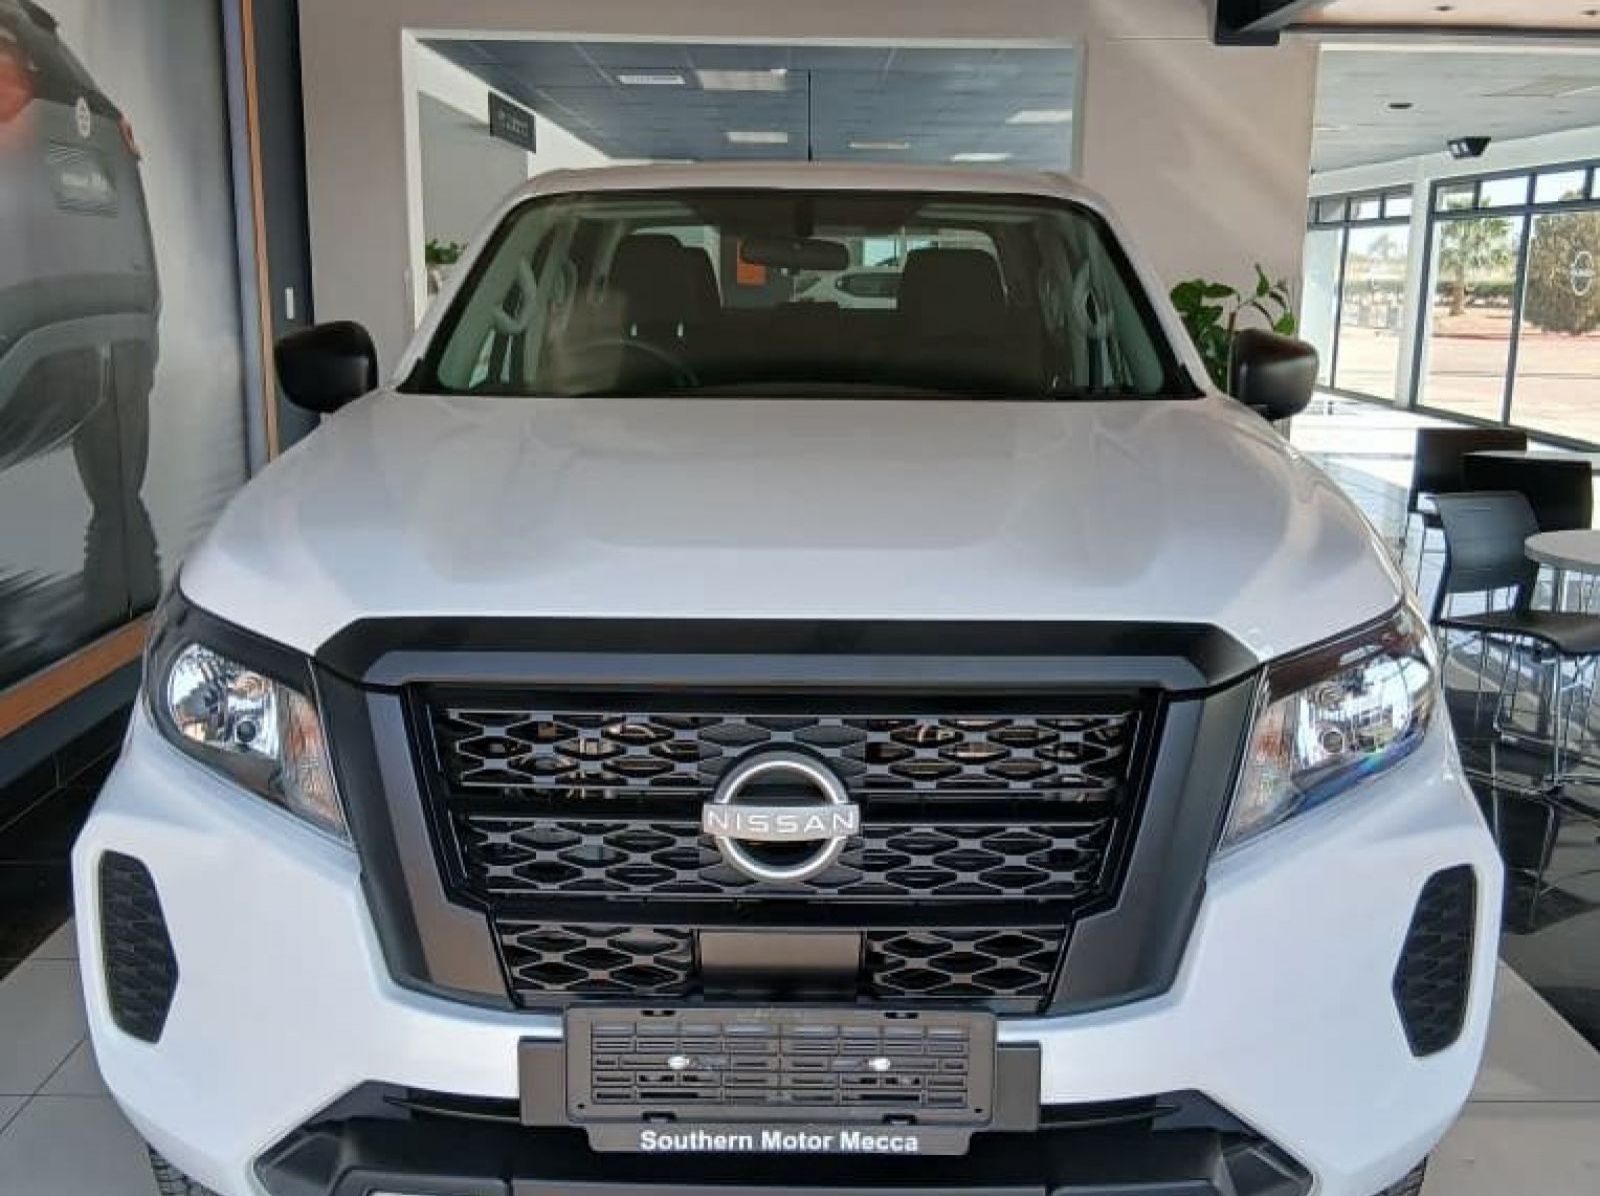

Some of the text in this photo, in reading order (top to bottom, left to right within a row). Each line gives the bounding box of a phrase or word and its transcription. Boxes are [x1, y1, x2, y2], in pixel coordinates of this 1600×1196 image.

[707, 810, 853, 833] NISSAN
[641, 1130, 919, 1153] Southern Motor Mecca
